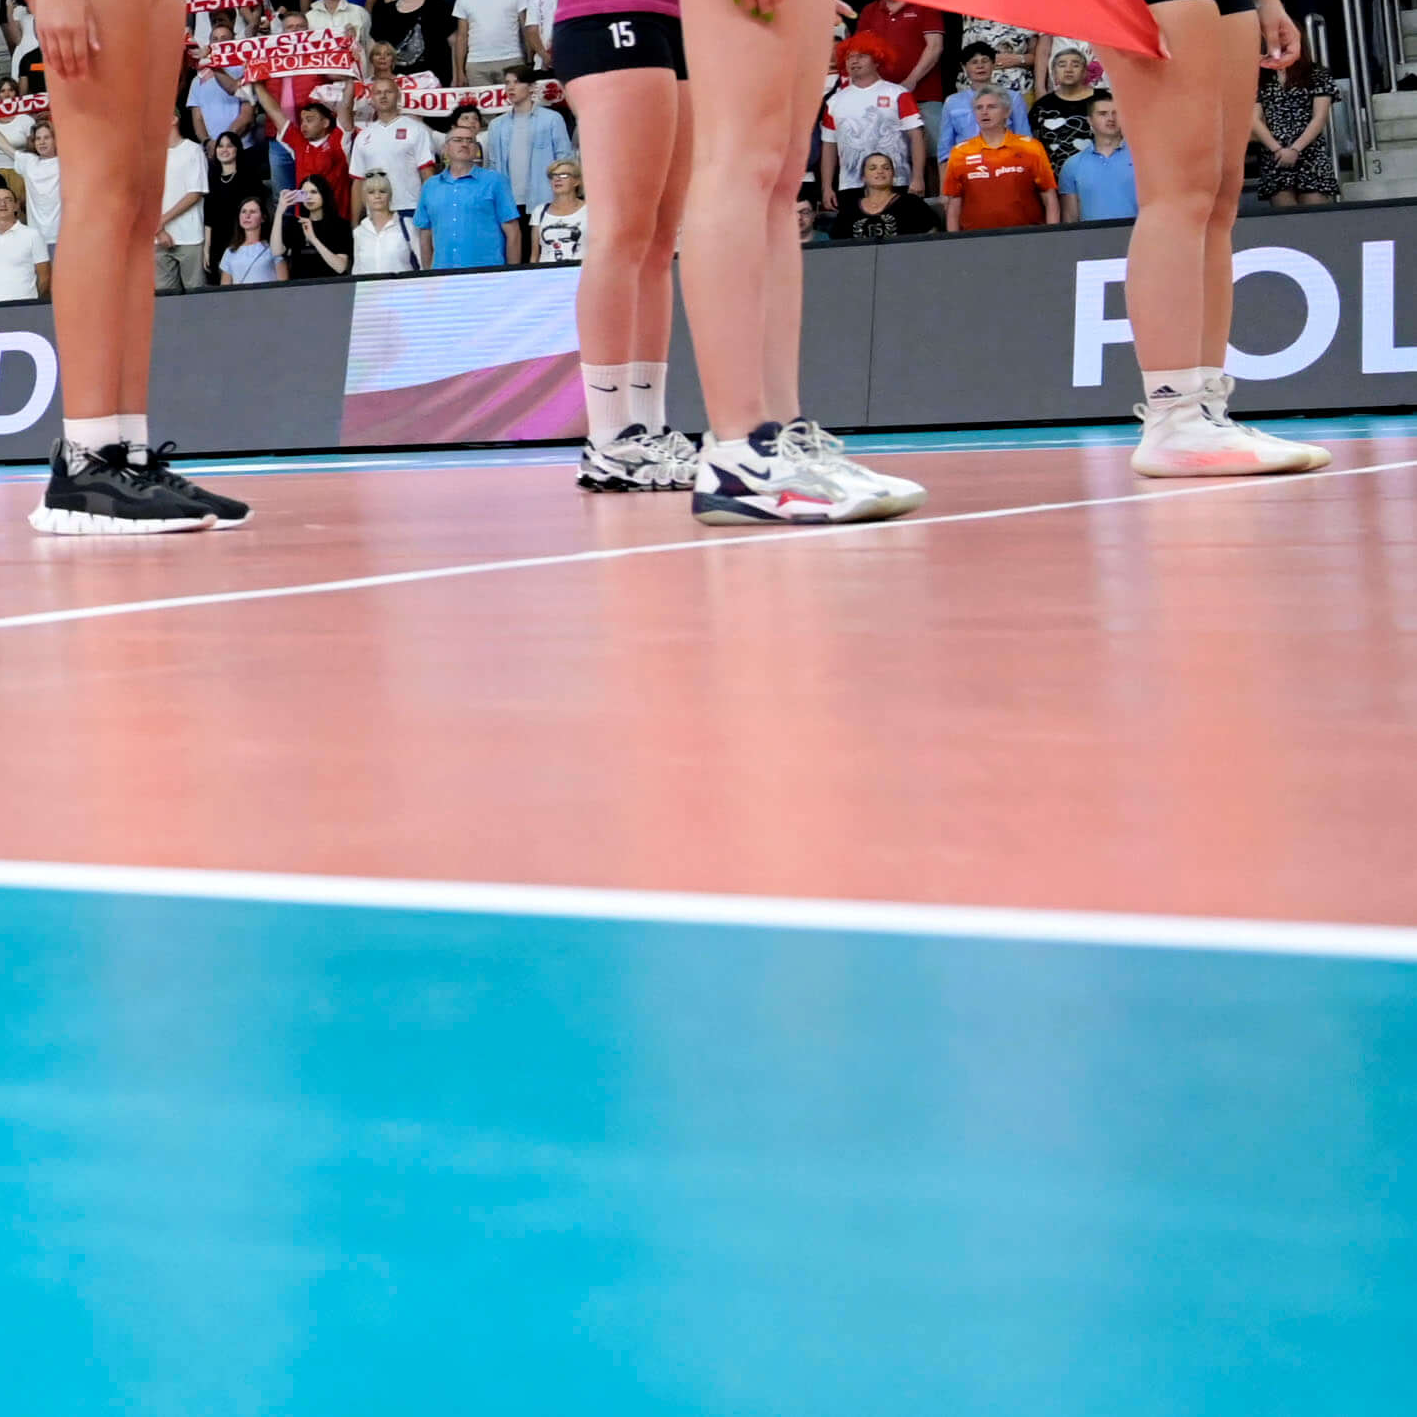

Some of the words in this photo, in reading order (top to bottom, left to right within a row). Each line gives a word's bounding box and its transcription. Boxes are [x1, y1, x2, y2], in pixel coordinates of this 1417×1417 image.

[219, 28, 338, 65] POLSKA
[609, 21, 636, 49] 15
[270, 51, 350, 71] POLSKA
[1372, 159, 1382, 175] 3
